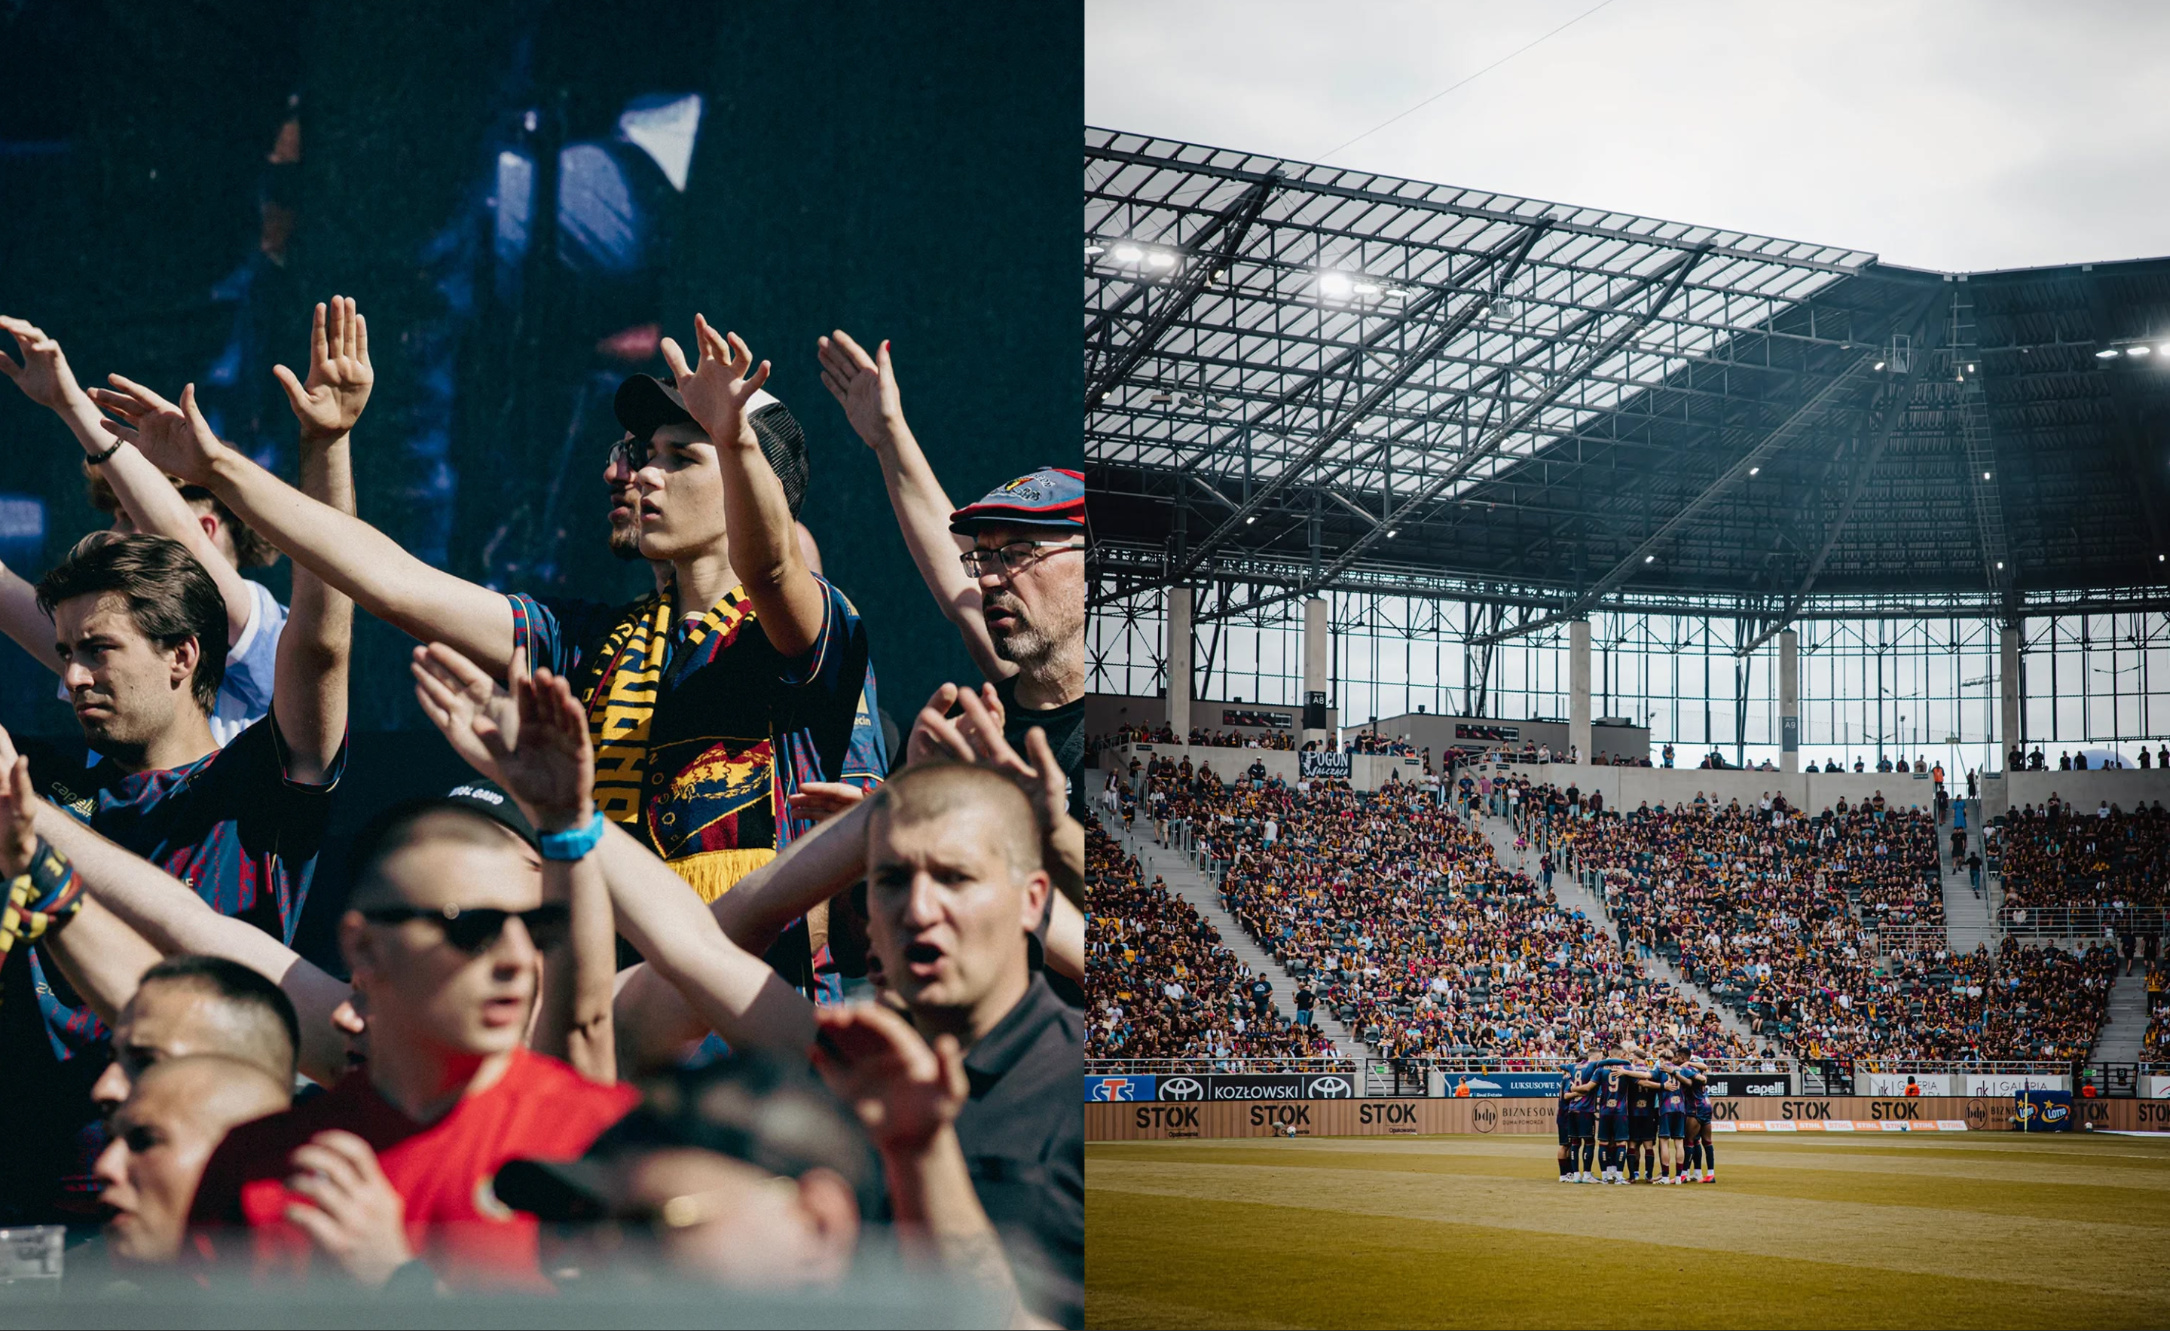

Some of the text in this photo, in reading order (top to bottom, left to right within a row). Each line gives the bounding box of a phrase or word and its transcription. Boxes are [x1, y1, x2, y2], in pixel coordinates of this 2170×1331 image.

[1312, 696, 1325, 705] A8
[1510, 1081, 1555, 1090] LUKSUSOWE
[1573, 1069, 1583, 1087] 8
[1608, 1071, 1619, 1093] 9
[1897, 1081, 1938, 1091] GERIA
[2000, 1081, 2047, 1091] GALRIA
[1214, 1085, 1299, 1099] KOZŁOWSKI
[1745, 1081, 1785, 1096] capelli
[1136, 1106, 1199, 1128] STOK
[1250, 1104, 1310, 1126] STOK
[1359, 1103, 1417, 1124] STOK
[1474, 1108, 1496, 1125] bdp
[1502, 1107, 1555, 1117] BIZNESOW
[1713, 1101, 1740, 1120] OK
[1782, 1101, 1831, 1120] STOK
[1871, 1101, 1919, 1120] STOK
[2047, 1107, 2068, 1119] LOTTO
